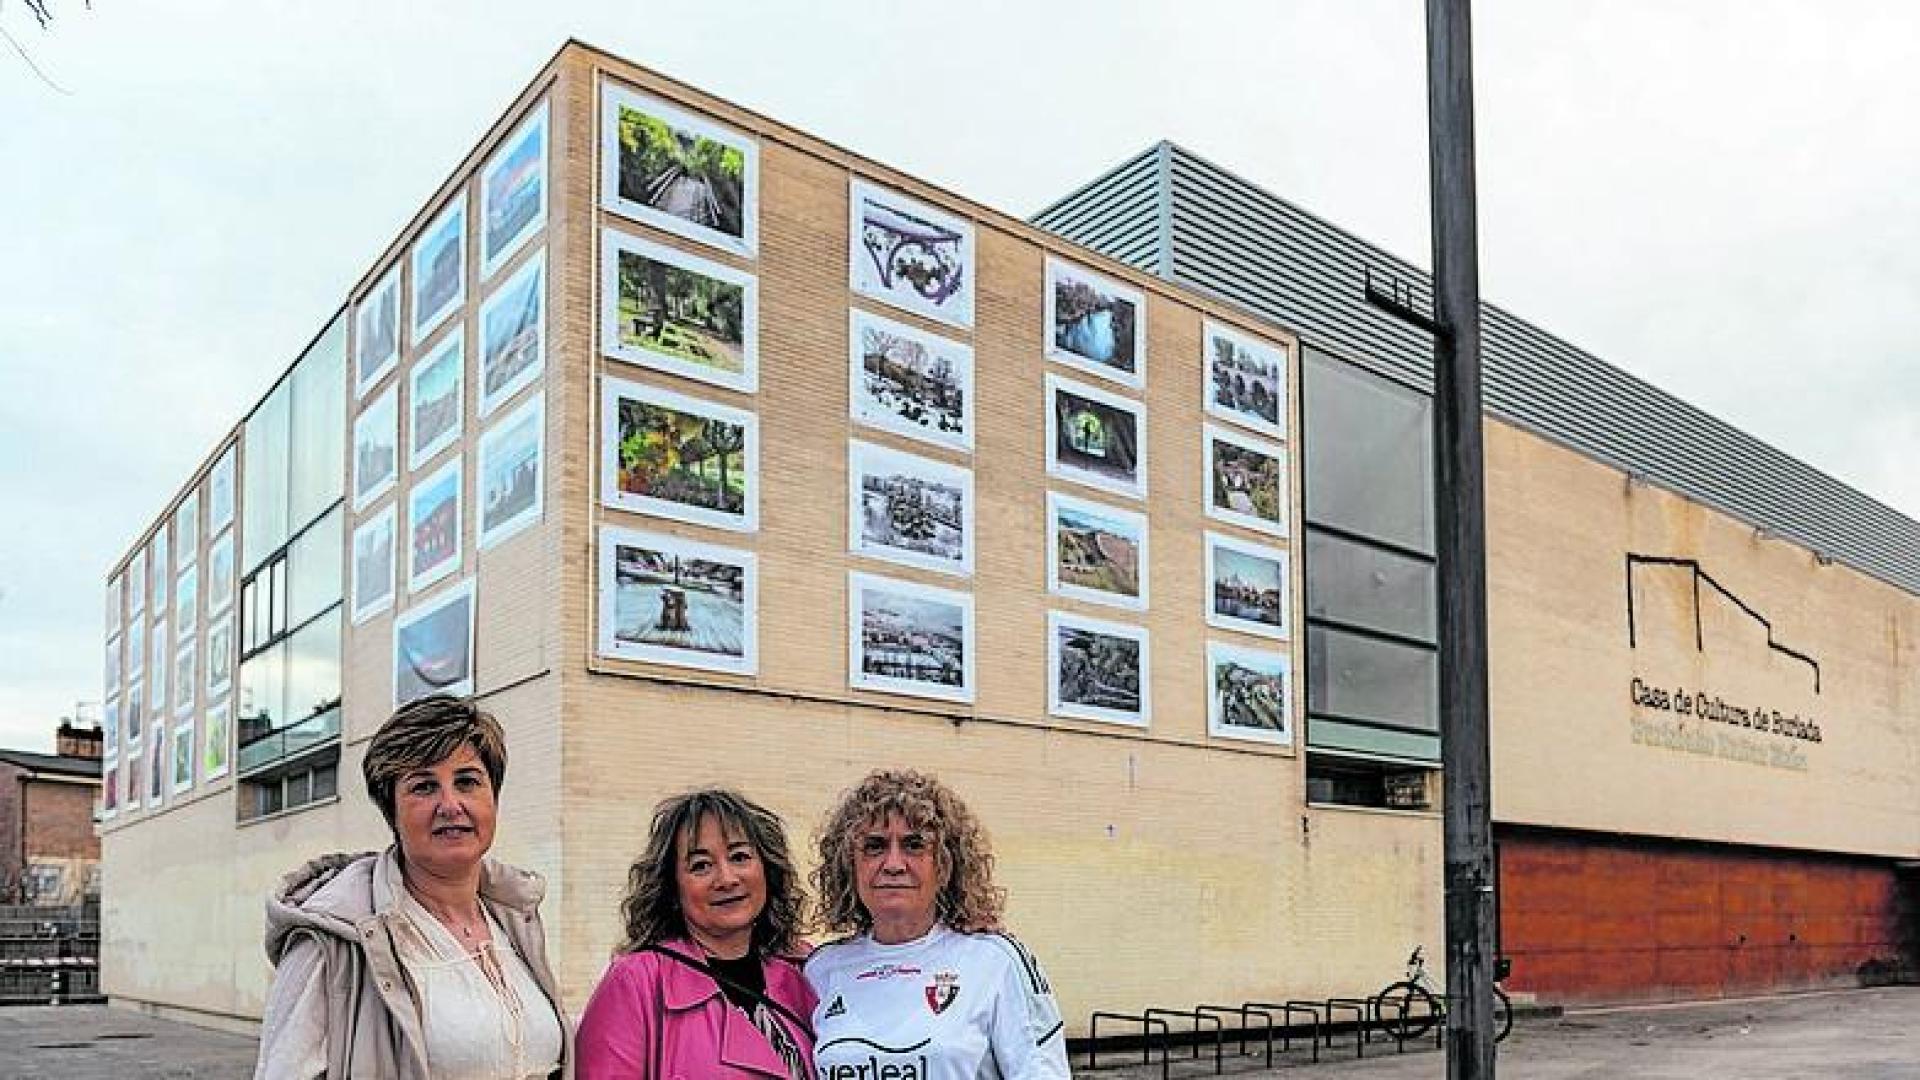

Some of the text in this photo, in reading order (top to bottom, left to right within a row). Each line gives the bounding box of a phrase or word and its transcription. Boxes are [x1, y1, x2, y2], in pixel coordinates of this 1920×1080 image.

[1631, 677, 1671, 710] Casa
[1674, 687, 1692, 715] de
[1696, 691, 1751, 727] Cultura
[1753, 706, 1769, 732] de
